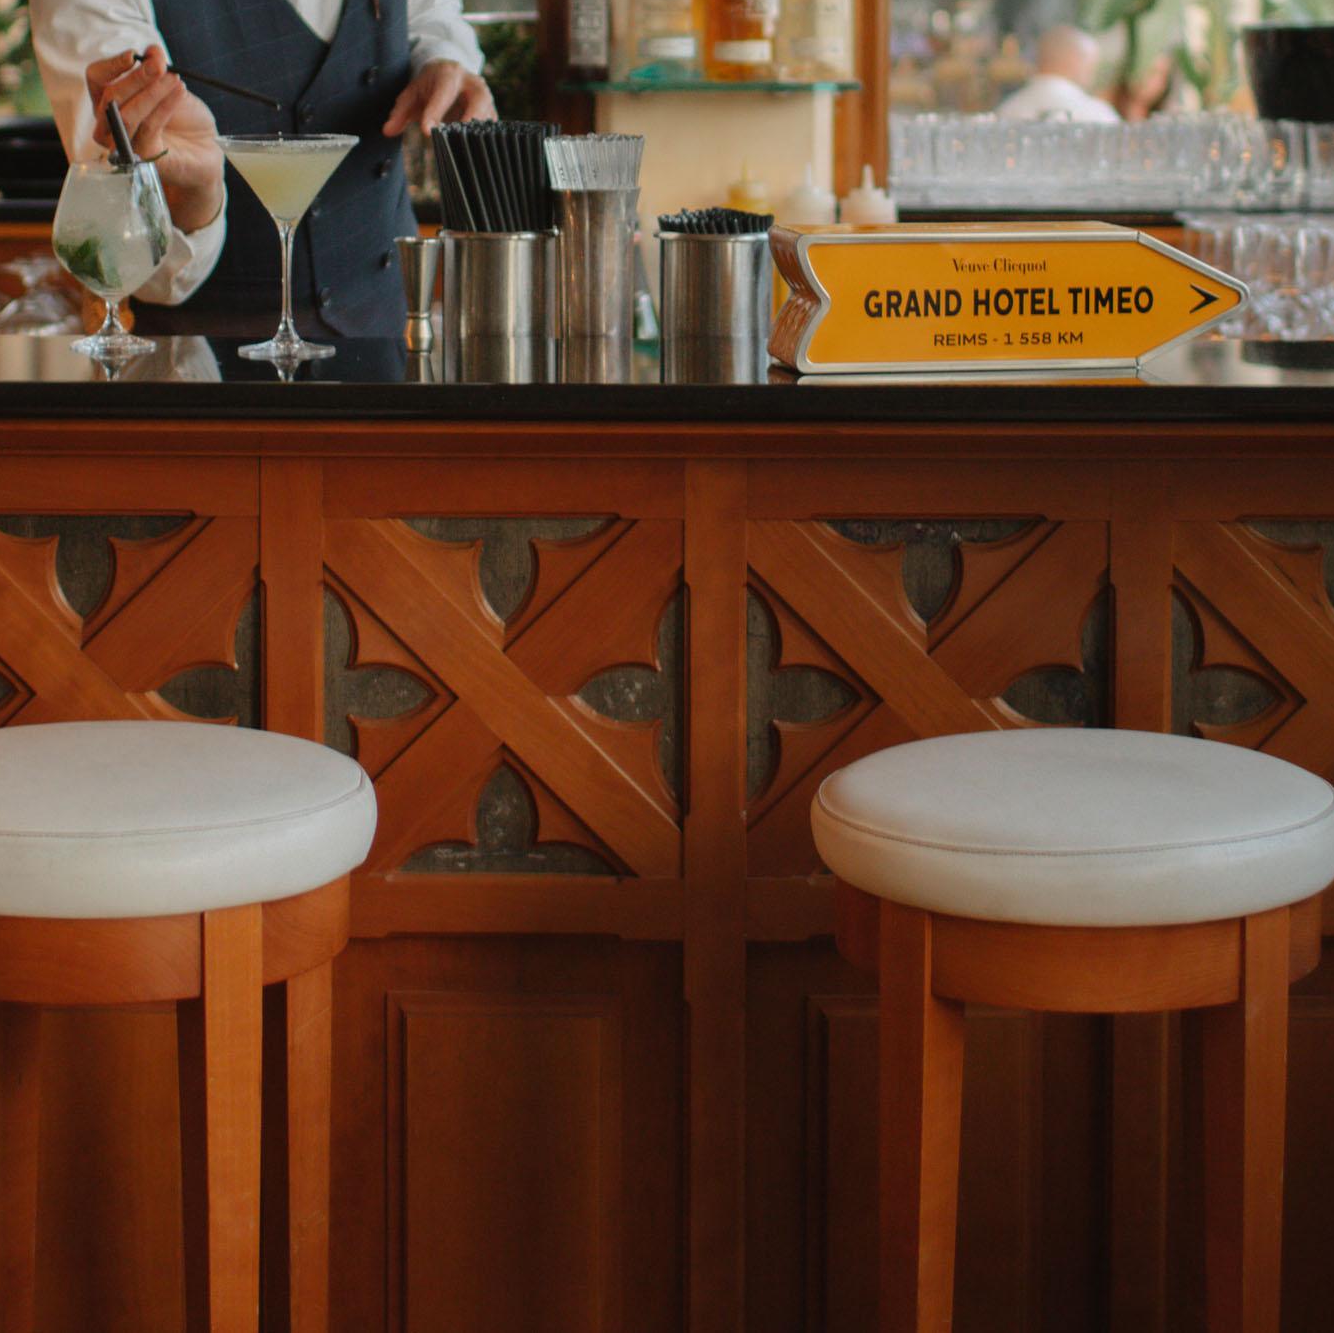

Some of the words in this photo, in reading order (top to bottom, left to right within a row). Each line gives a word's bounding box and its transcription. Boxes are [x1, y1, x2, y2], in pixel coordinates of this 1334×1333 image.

[952, 258, 989, 273] Veuve
[993, 257, 1047, 275] Clicquot
[863, 288, 963, 319] GRAND
[973, 287, 1061, 317] HOTEL
[1067, 285, 1155, 316] TIMEO
[933, 333, 988, 347] REIMS
[1003, 332, 1013, 346] 1
[1019, 331, 1052, 346] 558
[1057, 330, 1084, 345] KM
